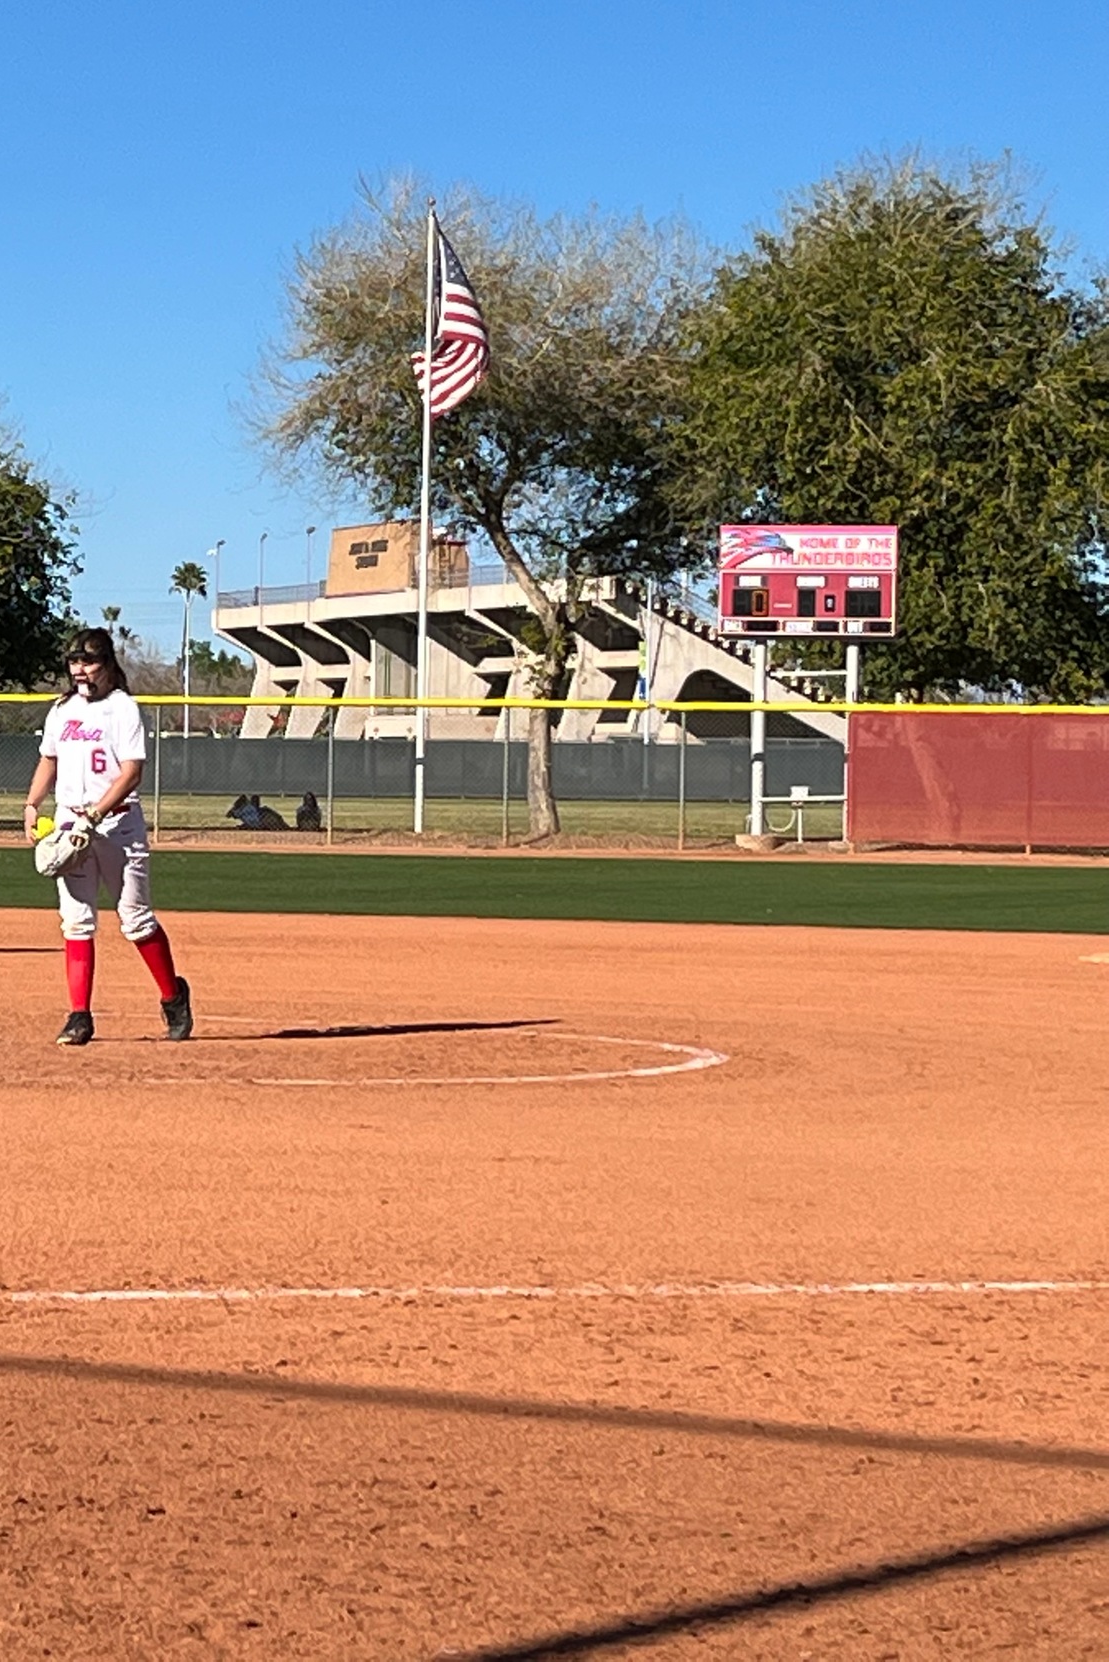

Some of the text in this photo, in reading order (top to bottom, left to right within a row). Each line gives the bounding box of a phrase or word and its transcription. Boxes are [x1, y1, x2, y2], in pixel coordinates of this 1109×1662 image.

[799, 537, 893, 549] HOME OF THE
[772, 551, 893, 566] THUNDERBIRDS
[91, 748, 107, 775] 6
